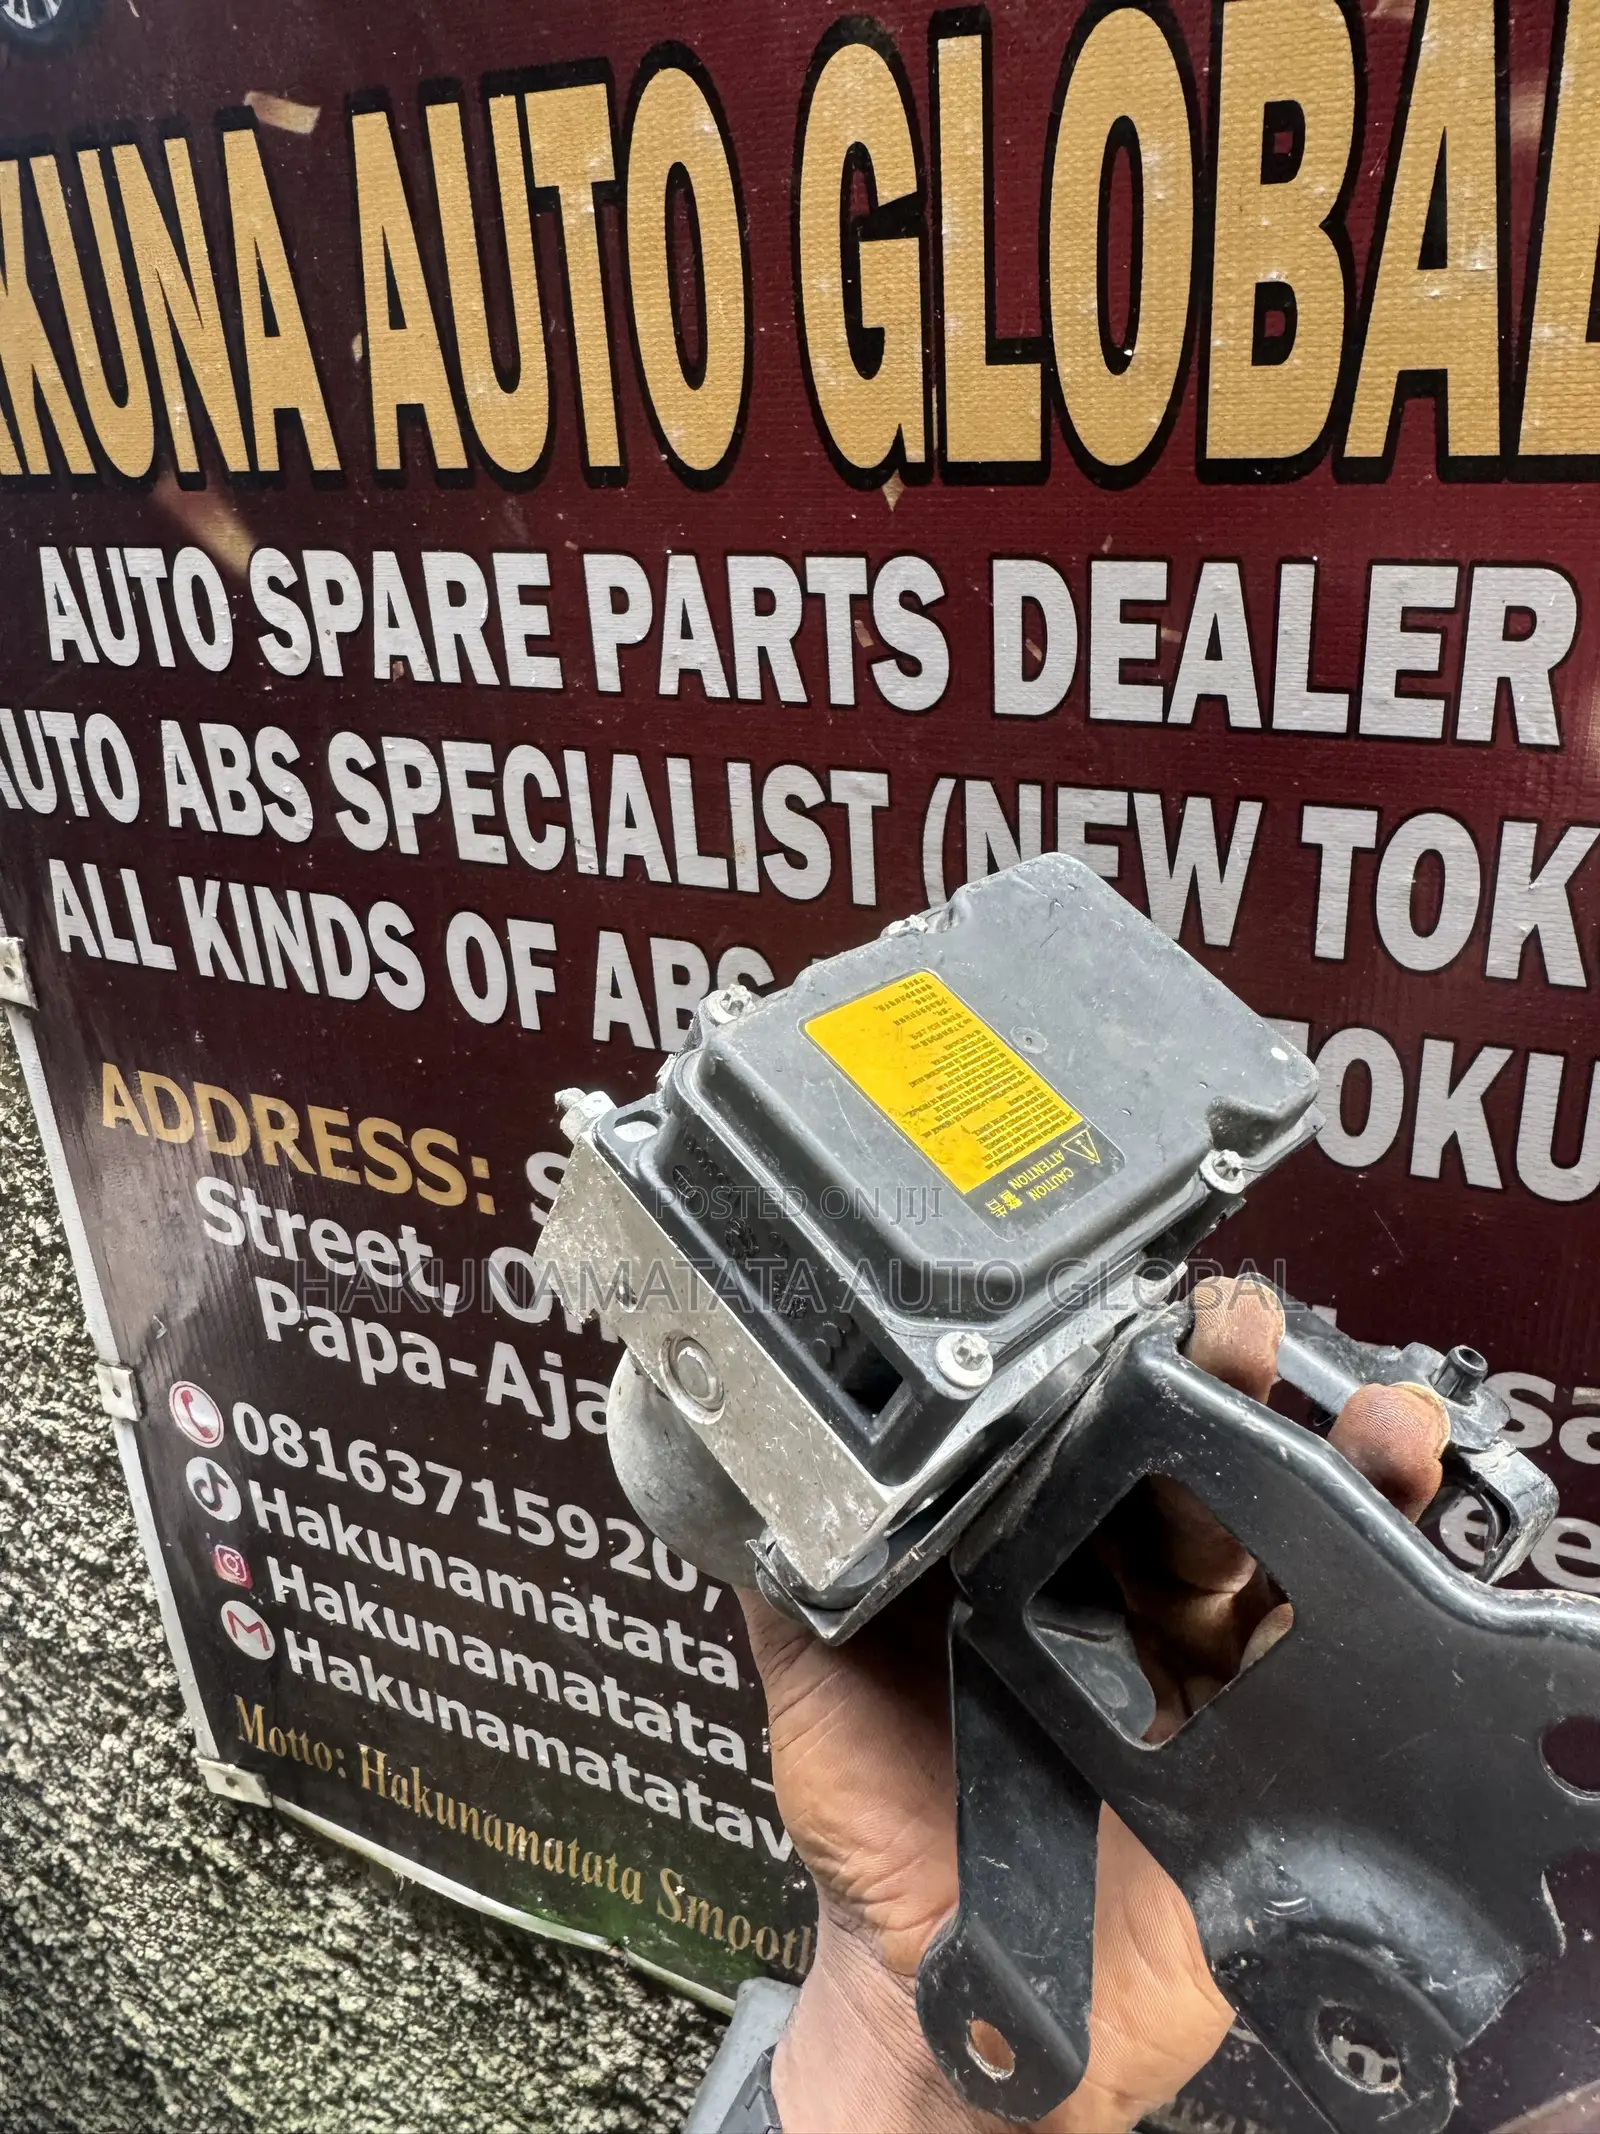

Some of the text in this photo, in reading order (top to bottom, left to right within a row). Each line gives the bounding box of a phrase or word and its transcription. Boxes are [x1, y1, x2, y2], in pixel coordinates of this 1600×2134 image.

[0, 0, 1600, 478] KUNA AUTO GLOBAL
[39, 546, 1578, 747] AUTO SPARE PARTS DEALER
[49, 858, 176, 972] ALL
[178, 875, 426, 1012] KINDS
[446, 911, 557, 1031] OF
[161, 719, 314, 842] ABS
[328, 731, 889, 906] SPECIALIST
[1301, 805, 1600, 988] TOK
[101, 1062, 496, 1216] ADDRESS:
[1007, 1149, 1065, 1190] ATTENTION
[1026, 1167, 1074, 1201] CAUTION
[1262, 1017, 1600, 1202] OKU
[196, 1176, 460, 1318] Street,
[233, 1402, 725, 1613] 08163715920,
[250, 1480, 740, 1692] Hakunamatata
[234, 1694, 346, 1778] Motto:
[357, 1742, 644, 1905] Hakunamatata
[286, 1628, 795, 1862] Hakunamatatav
